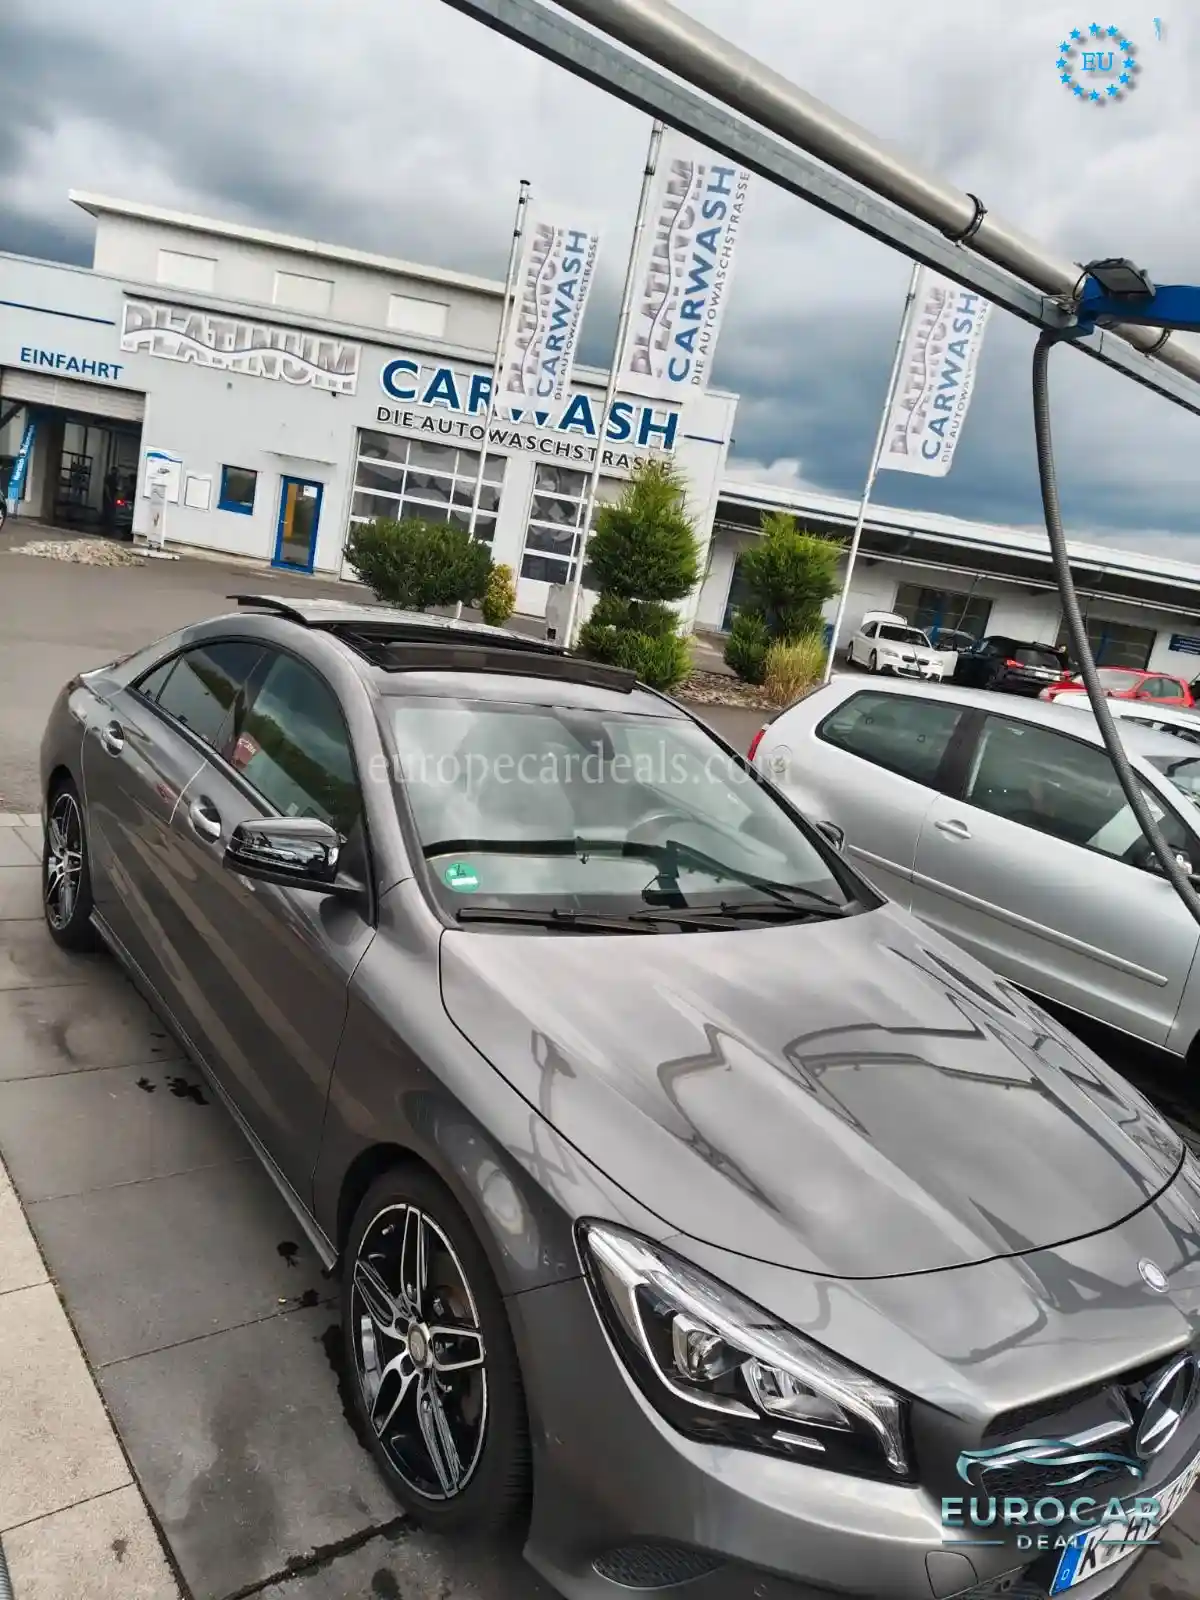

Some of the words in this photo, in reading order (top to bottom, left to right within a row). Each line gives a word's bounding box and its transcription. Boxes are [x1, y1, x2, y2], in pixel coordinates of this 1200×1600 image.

[122, 300, 360, 395] PLATINUM
[536, 230, 588, 397] CARWASH
[554, 380, 565, 400] DIE
[560, 235, 599, 376] AUTOWASCHSTRASSE
[667, 165, 736, 382] CARWASH
[691, 360, 705, 386] DIE
[698, 171, 751, 356] AUTOWASCHSTRASSE
[20, 346, 124, 380] EINFAHRT
[377, 406, 414, 428] DIE
[921, 292, 979, 460] CARWASH
[942, 443, 954, 463] DIE
